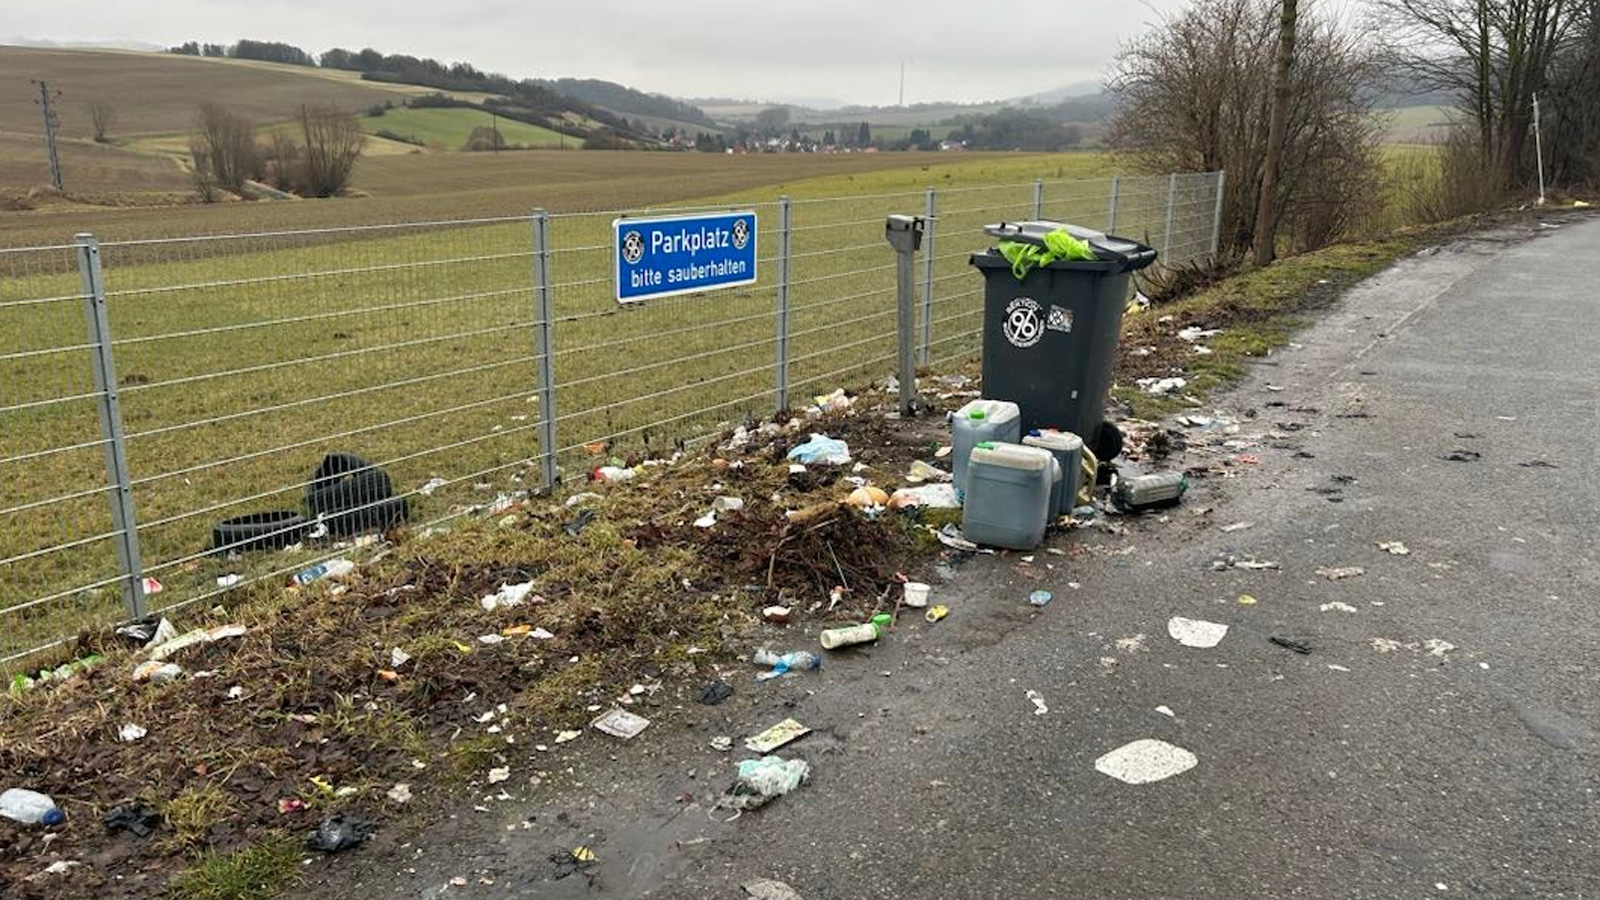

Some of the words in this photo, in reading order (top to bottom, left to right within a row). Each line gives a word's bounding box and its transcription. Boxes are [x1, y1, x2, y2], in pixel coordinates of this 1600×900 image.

[651, 227, 729, 256] Parkplatz
[631, 268, 662, 288] bitte
[667, 258, 746, 283] sauberhalten
[1012, 310, 1035, 339] 96
